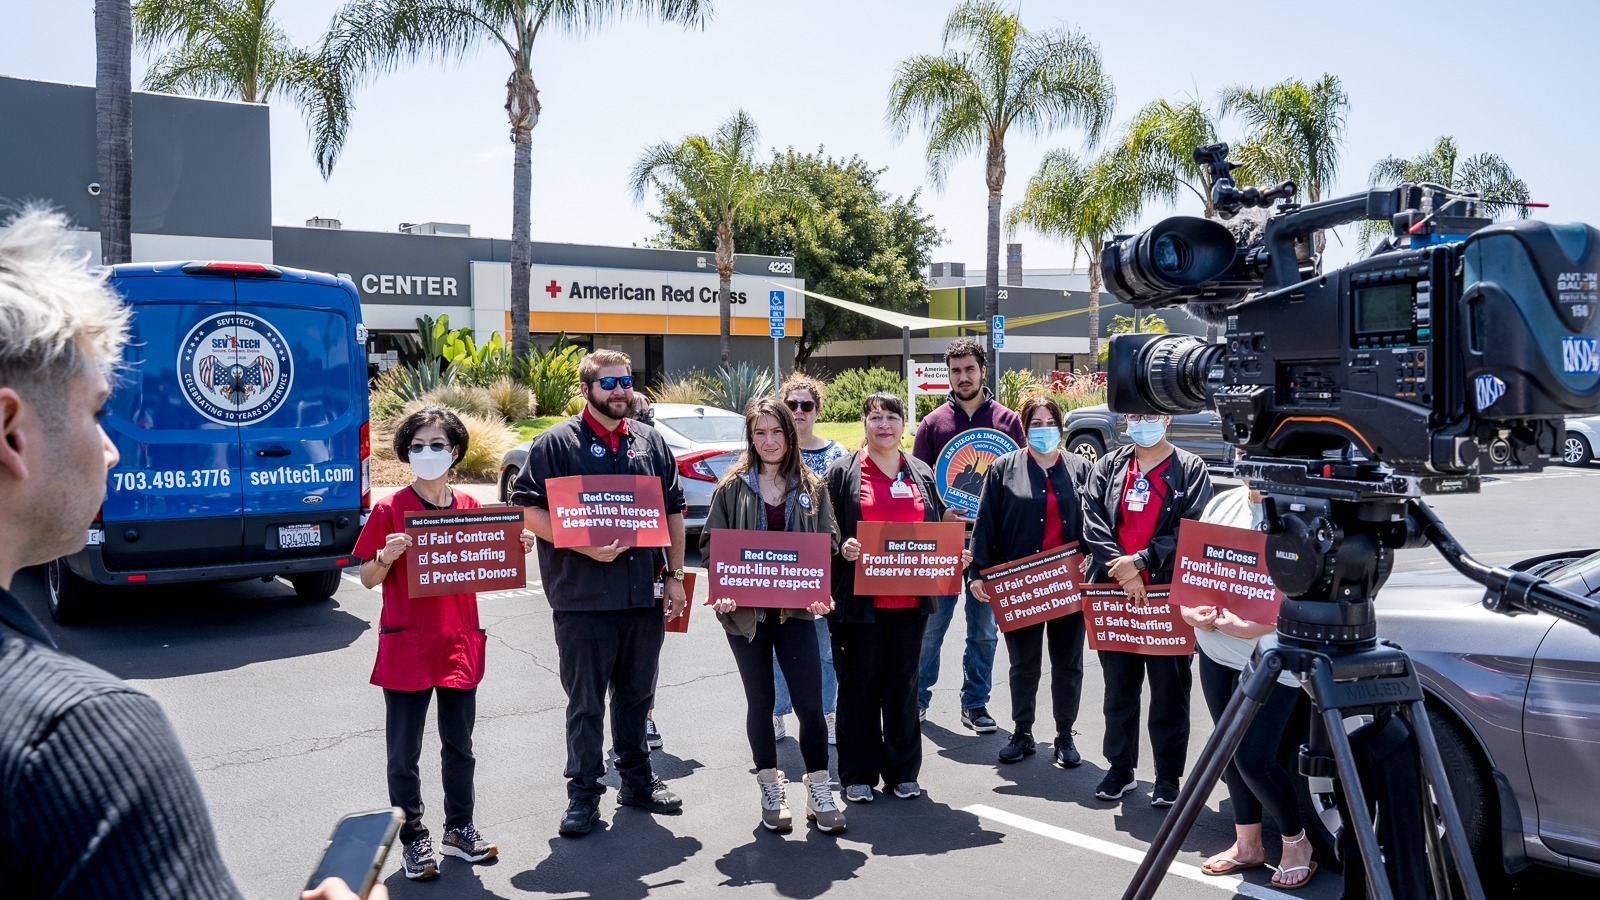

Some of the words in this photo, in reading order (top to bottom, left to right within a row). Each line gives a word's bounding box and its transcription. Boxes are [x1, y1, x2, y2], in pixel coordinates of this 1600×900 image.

[768, 261, 792, 274] 4229
[361, 274, 458, 296] CENTER
[568, 282, 655, 300] American
[661, 284, 694, 302] Red
[698, 287, 747, 304] Crss
[216, 318, 254, 327] SEV1TECH
[212, 336, 260, 348] SEV1TECH
[184, 373, 222, 416] CELEBRATING
[236, 409, 262, 420] YEARS
[262, 401, 272, 411] OF
[273, 373, 288, 403] SERVICE
[944, 447, 955, 460] SAN
[955, 434, 976, 448] DIEGO
[983, 433, 1014, 452] IMPERIAL
[114, 469, 230, 491] 703.496.3776
[250, 466, 354, 486] sev1tech.com
[583, 493, 602, 502] Red
[604, 493, 634, 502] Cross:
[948, 488, 967, 499] LABOR
[557, 504, 618, 517] Front-line
[620, 505, 660, 517] heroes
[562, 518, 612, 528] deserve
[615, 518, 658, 530] respect
[430, 532, 454, 545] Fair
[455, 529, 505, 543] Contract
[888, 542, 906, 550] Red
[907, 542, 936, 551] Cross:
[431, 551, 458, 564] Safe
[460, 548, 505, 562] Staffing
[744, 550, 764, 560] Red
[766, 551, 797, 561] Cross:
[862, 553, 918, 564] Front-line
[921, 554, 958, 564] heroes
[1206, 546, 1225, 558] Red
[1226, 551, 1256, 564] Cross:
[1276, 550, 1296, 560] MILLER
[432, 569, 476, 584] Protect
[478, 567, 517, 580] Donors
[716, 562, 778, 575] Front-line
[781, 564, 824, 577] heroes
[865, 566, 911, 576] deserve
[914, 566, 955, 578] respect
[1004, 578, 1024, 590] Fair
[1024, 564, 1068, 584] Contract
[1180, 556, 1236, 578] Front-line
[1238, 567, 1275, 586] heroe
[720, 575, 771, 587] deserve
[773, 578, 820, 591] respect
[1182, 572, 1227, 591] deserve
[1229, 583, 1276, 601] respect
[1010, 592, 1032, 605] Safe
[1033, 580, 1073, 598] Staffing
[1014, 601, 1051, 619] Protect
[1051, 592, 1081, 608] Donor
[1102, 601, 1123, 611] Fair
[1126, 603, 1171, 615] Contract
[1105, 616, 1130, 627] Safe
[1131, 619, 1173, 632] Staffing
[1108, 631, 1145, 644] Protect
[1146, 635, 1186, 645] Donors
[1344, 682, 1402, 701] MILLER
